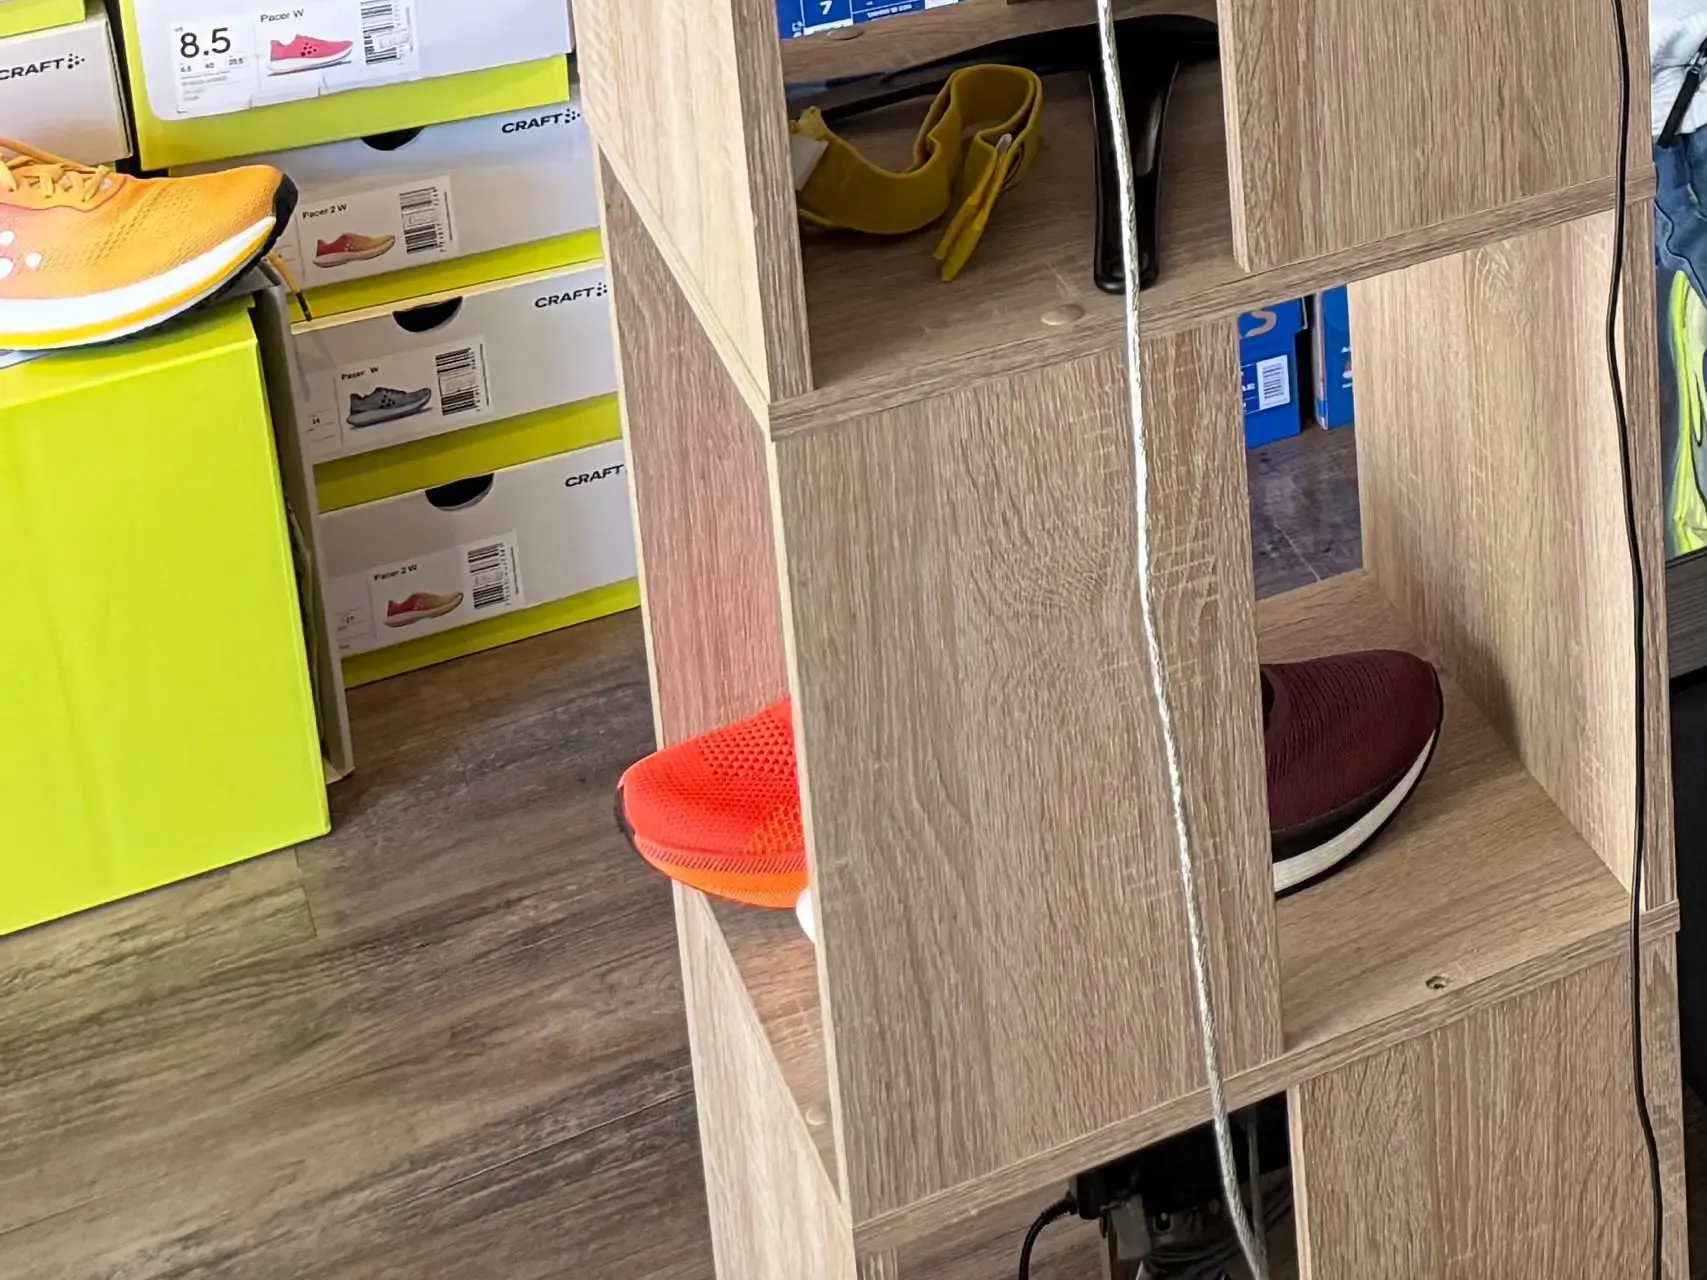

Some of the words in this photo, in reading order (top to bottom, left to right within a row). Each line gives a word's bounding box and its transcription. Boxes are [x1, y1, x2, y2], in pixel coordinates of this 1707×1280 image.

[293, 10, 304, 18] W
[820, 0, 832, 15] 7
[180, 28, 231, 58] 8.5
[501, 113, 564, 133] CRAFT
[534, 287, 595, 308] CRAFT
[564, 465, 625, 488] CRAFT
